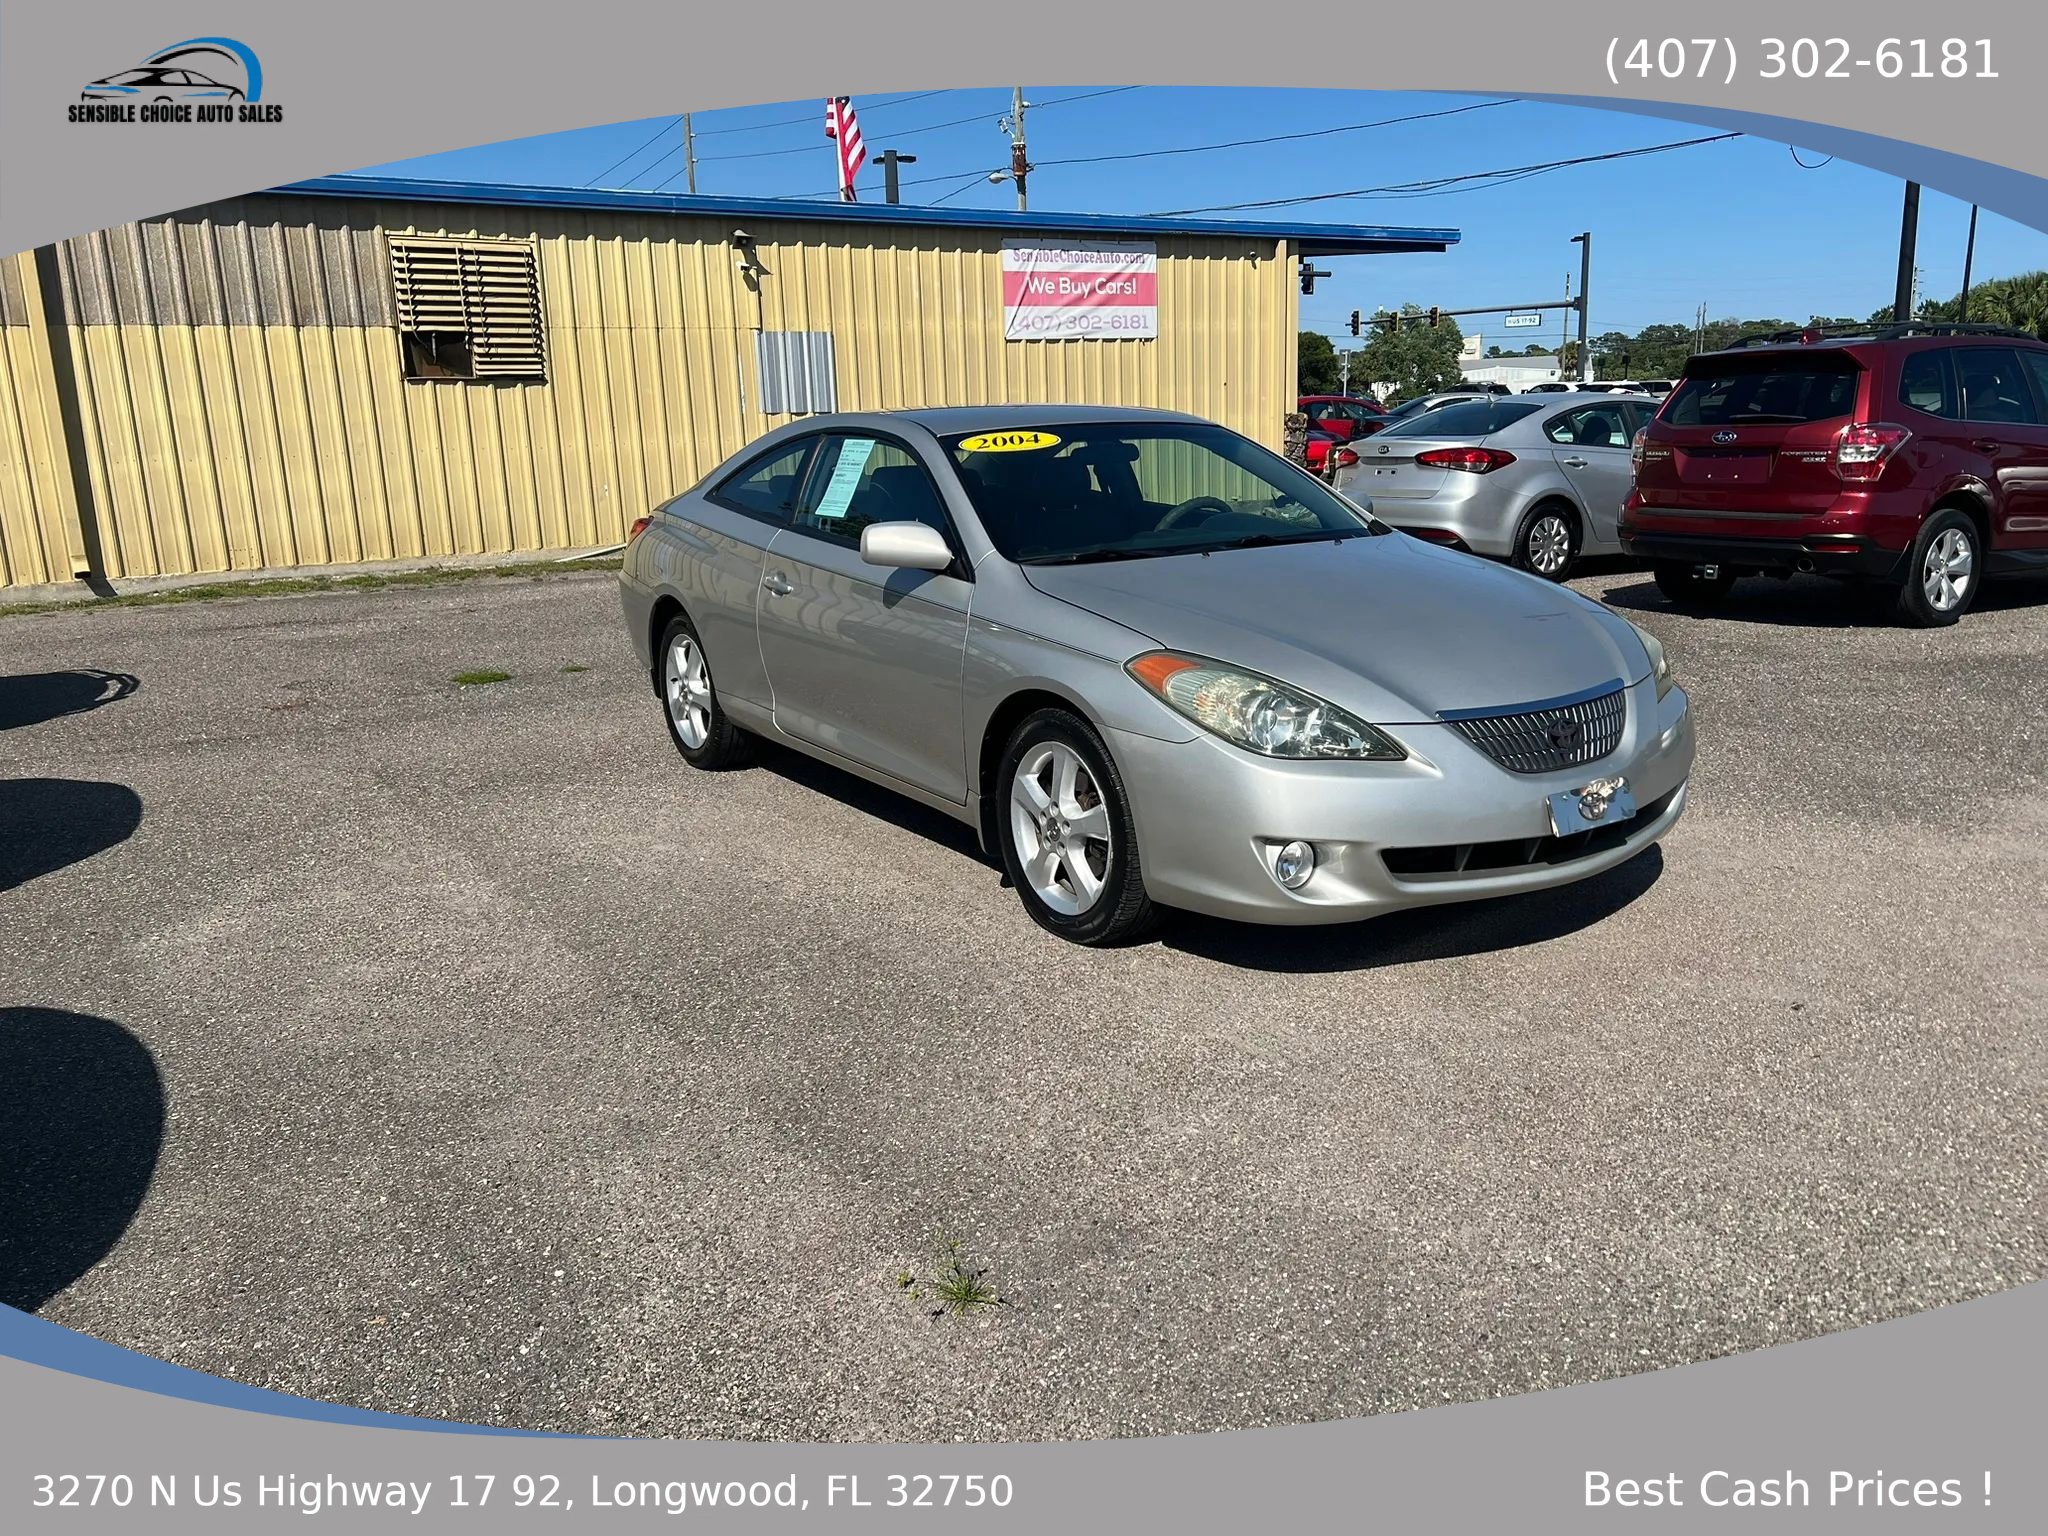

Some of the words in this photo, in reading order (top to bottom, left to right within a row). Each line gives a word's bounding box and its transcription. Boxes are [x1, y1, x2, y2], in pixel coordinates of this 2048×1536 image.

[1027, 277, 1055, 294] We
[1059, 277, 1091, 298] Buy
[1095, 277, 1137, 294] Cars!
[1066, 314, 1149, 330] 302-6181
[976, 433, 1041, 449] 2004
